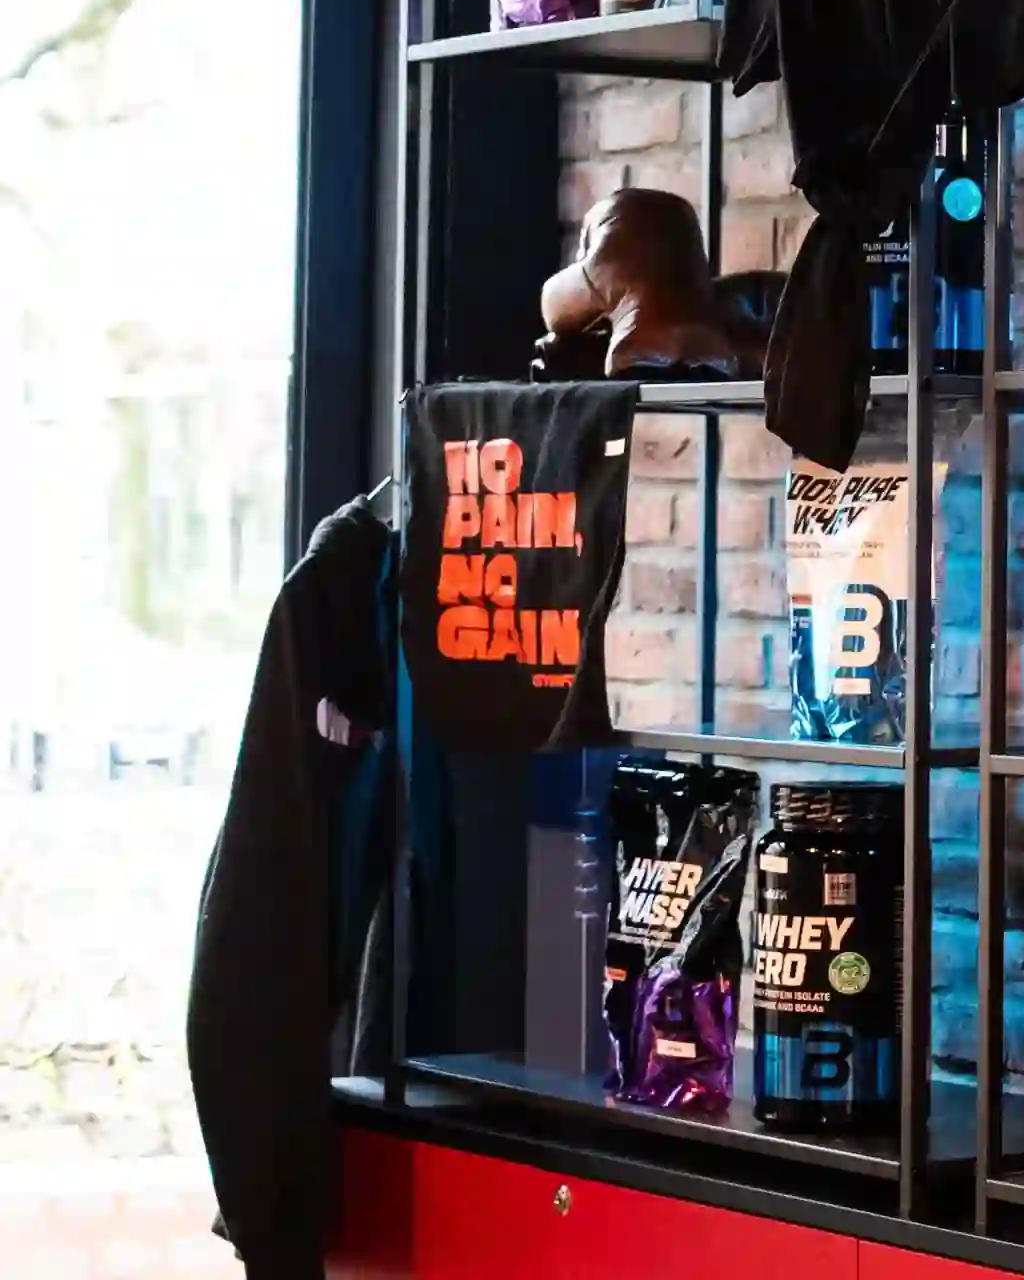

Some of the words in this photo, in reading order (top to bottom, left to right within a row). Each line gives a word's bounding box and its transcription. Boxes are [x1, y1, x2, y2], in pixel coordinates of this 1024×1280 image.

[444, 438, 523, 494] NO
[443, 491, 584, 557] PAIN,
[438, 553, 517, 608] NO
[437, 604, 580, 666] GAIN
[757, 911, 856, 951] WHEY
[794, 991, 831, 1002] ISOLATE
[794, 1003, 824, 1013] BCAAs
